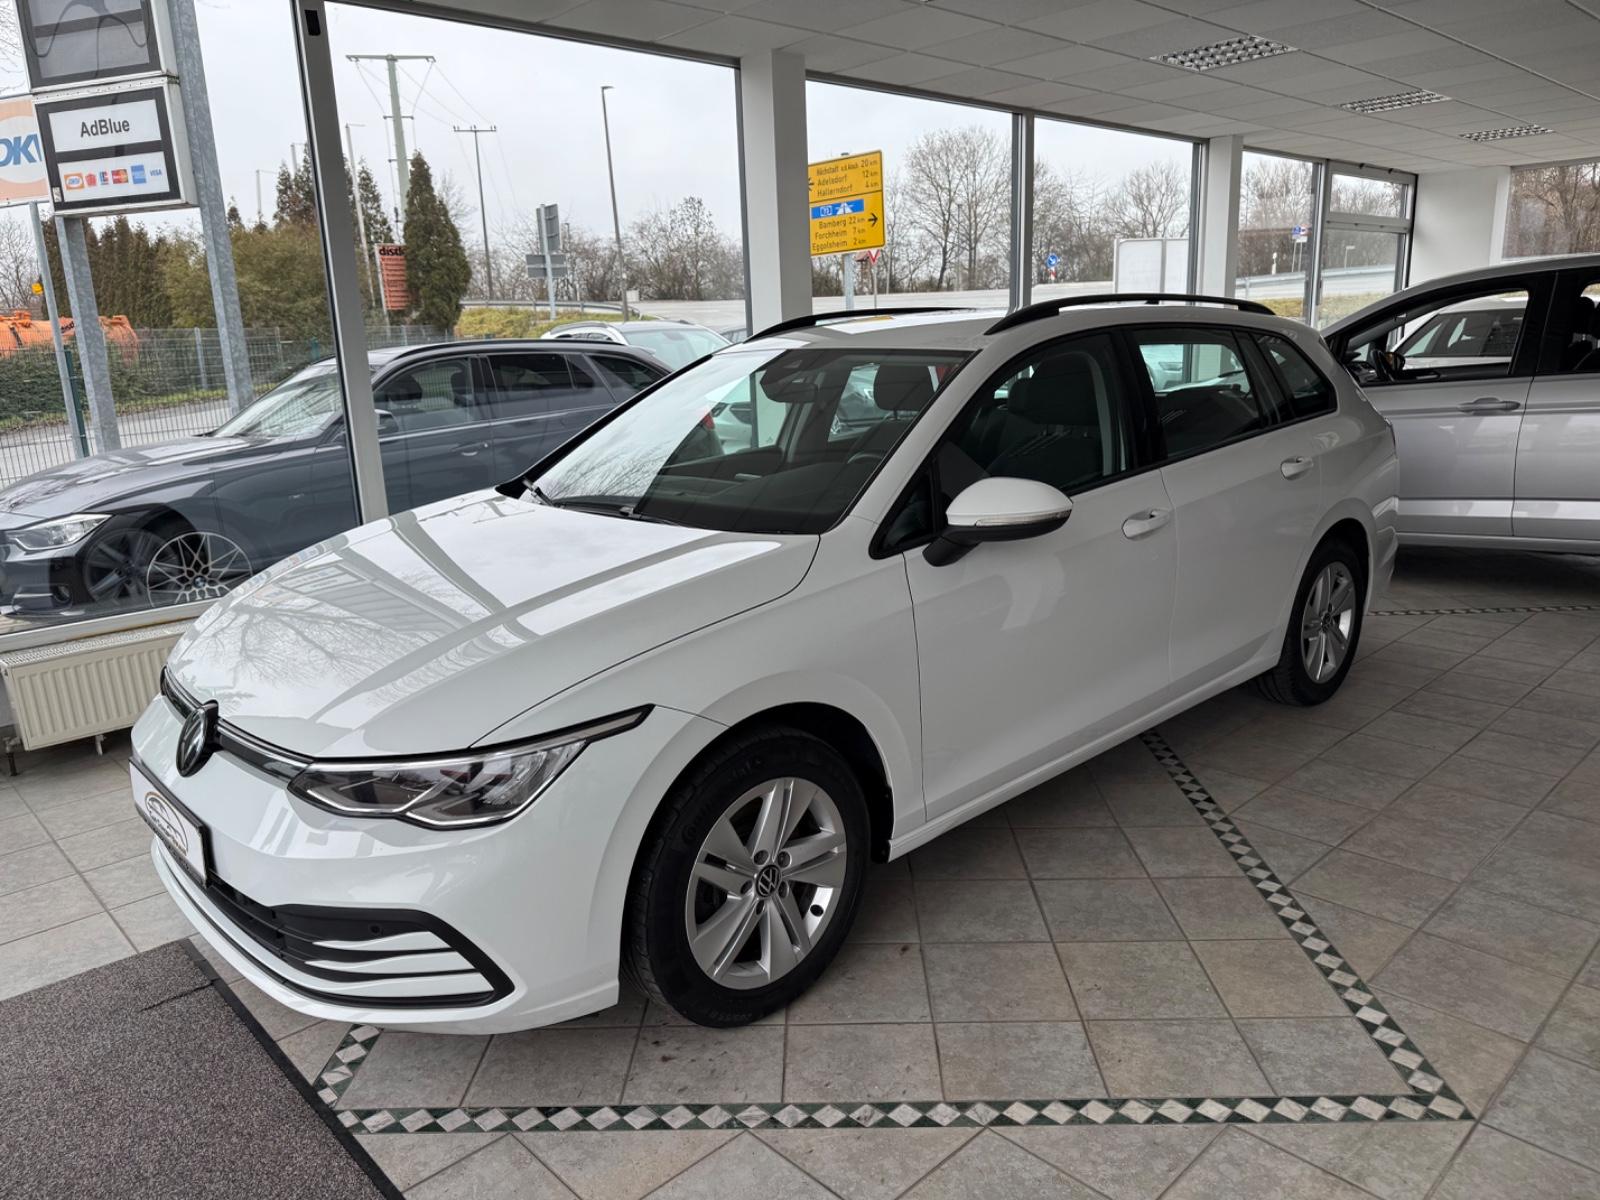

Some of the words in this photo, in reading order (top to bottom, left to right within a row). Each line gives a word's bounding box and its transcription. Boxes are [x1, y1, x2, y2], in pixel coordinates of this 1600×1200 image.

[80, 118, 131, 138] AdBlue
[149, 168, 162, 177] VISA
[818, 219, 847, 230] Bamberg
[848, 216, 857, 225] 22
[815, 229, 848, 240] Forchheim
[811, 239, 848, 252] Eggolsheim
